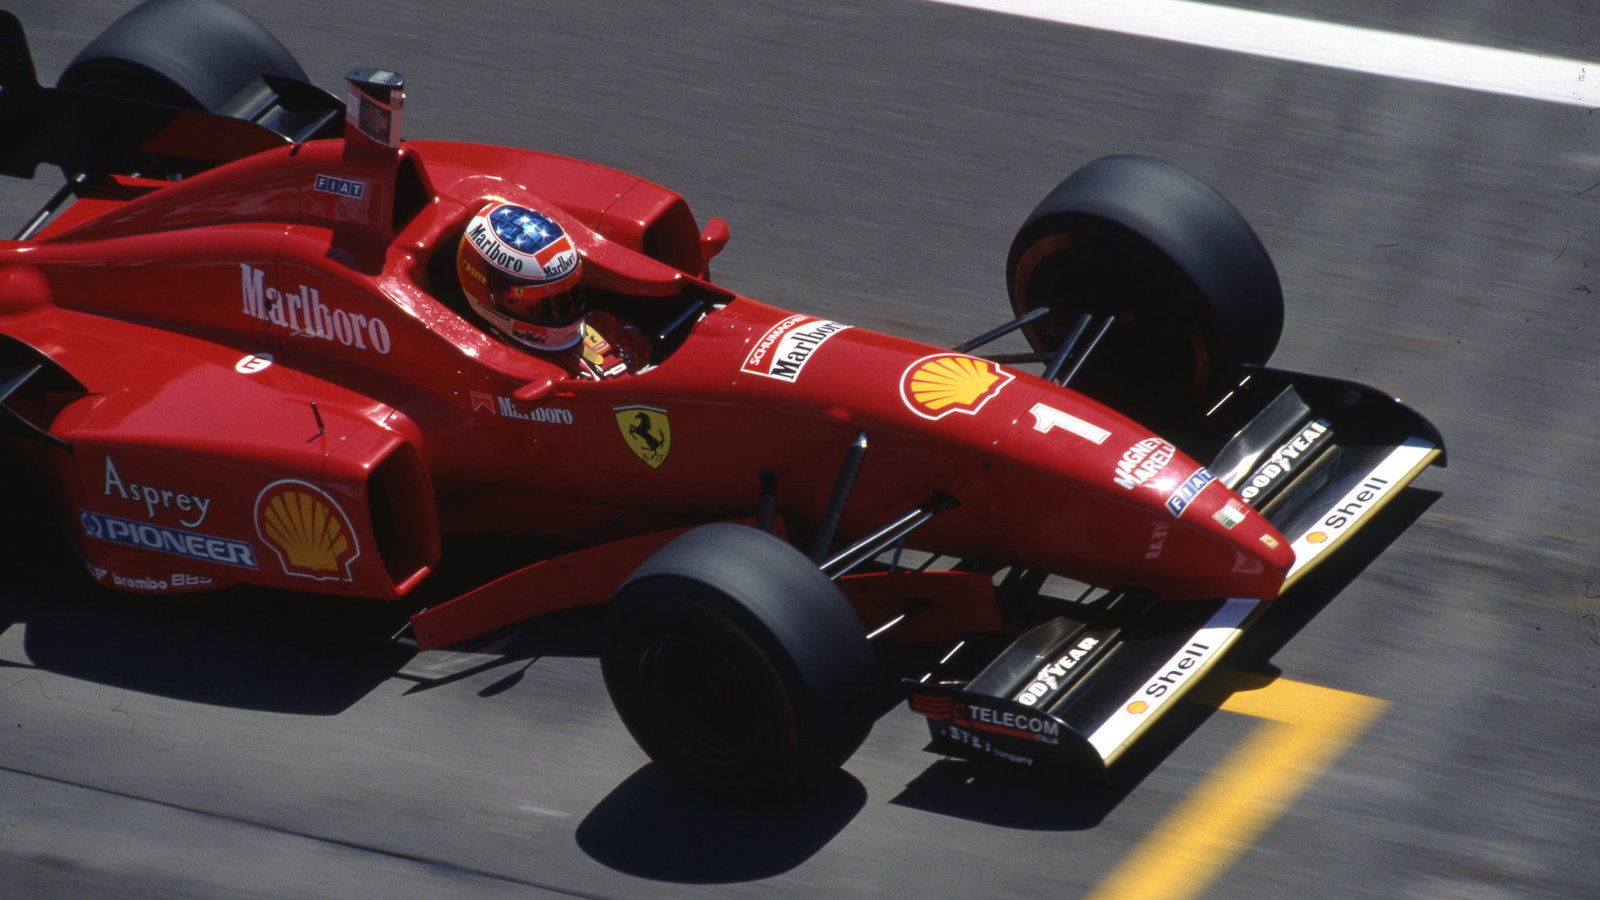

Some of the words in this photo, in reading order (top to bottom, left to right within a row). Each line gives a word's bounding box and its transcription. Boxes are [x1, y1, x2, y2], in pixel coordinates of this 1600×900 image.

[317, 176, 362, 196] FIAT
[468, 223, 523, 273] Marlboro
[240, 262, 391, 354] Marlboro
[1029, 402, 1112, 445] 1
[1241, 422, 1327, 503] OODYEA
[103, 455, 211, 528] Asprey
[1171, 468, 1215, 511] FIAT
[1324, 476, 1388, 529] Shell
[106, 518, 255, 567] PIONEER
[112, 572, 168, 590] brembo
[1145, 642, 1210, 698] Shell
[968, 705, 1060, 736] TELECOM
